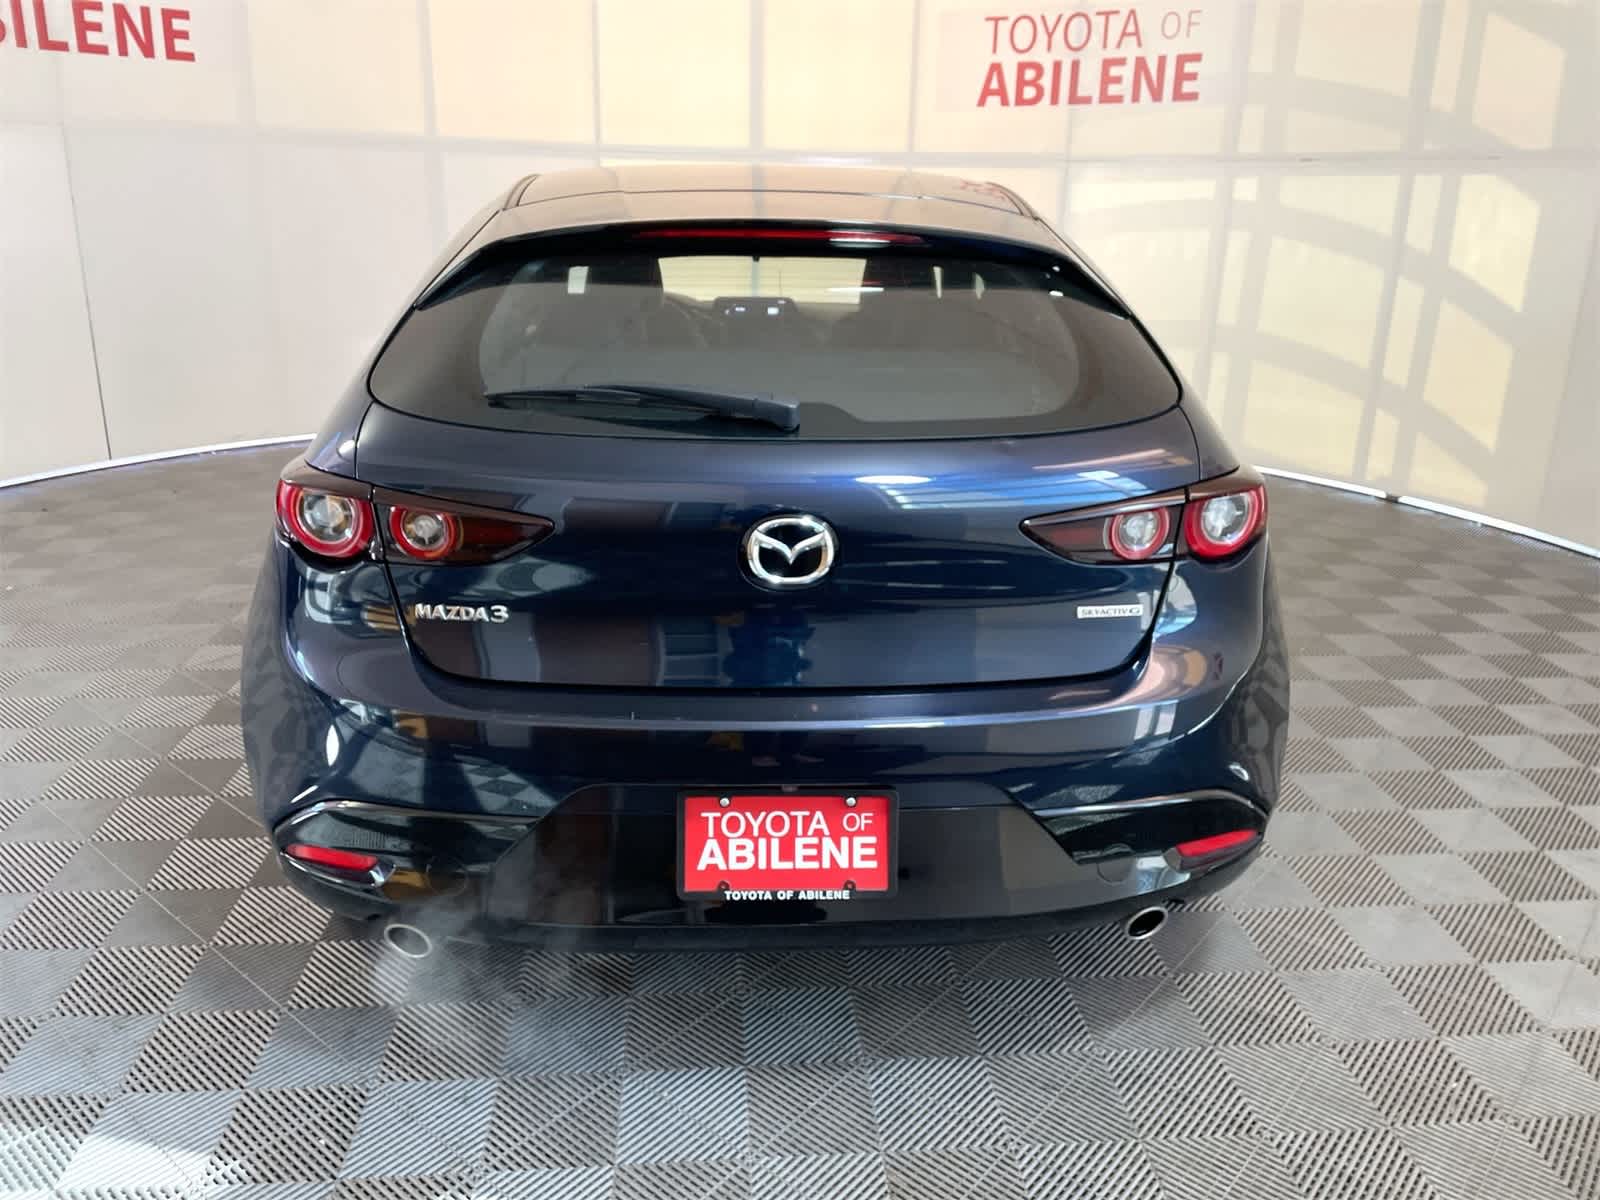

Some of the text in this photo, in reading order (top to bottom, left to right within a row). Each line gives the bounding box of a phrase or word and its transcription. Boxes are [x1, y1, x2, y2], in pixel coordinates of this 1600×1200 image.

[985, 9, 1203, 54] TOYOTA OF
[976, 53, 1203, 107] ABILENE
[701, 811, 874, 838] TOYOTA OF
[696, 836, 878, 871] ABILENE
[724, 890, 850, 900] TOYOTA OF ABILENE
